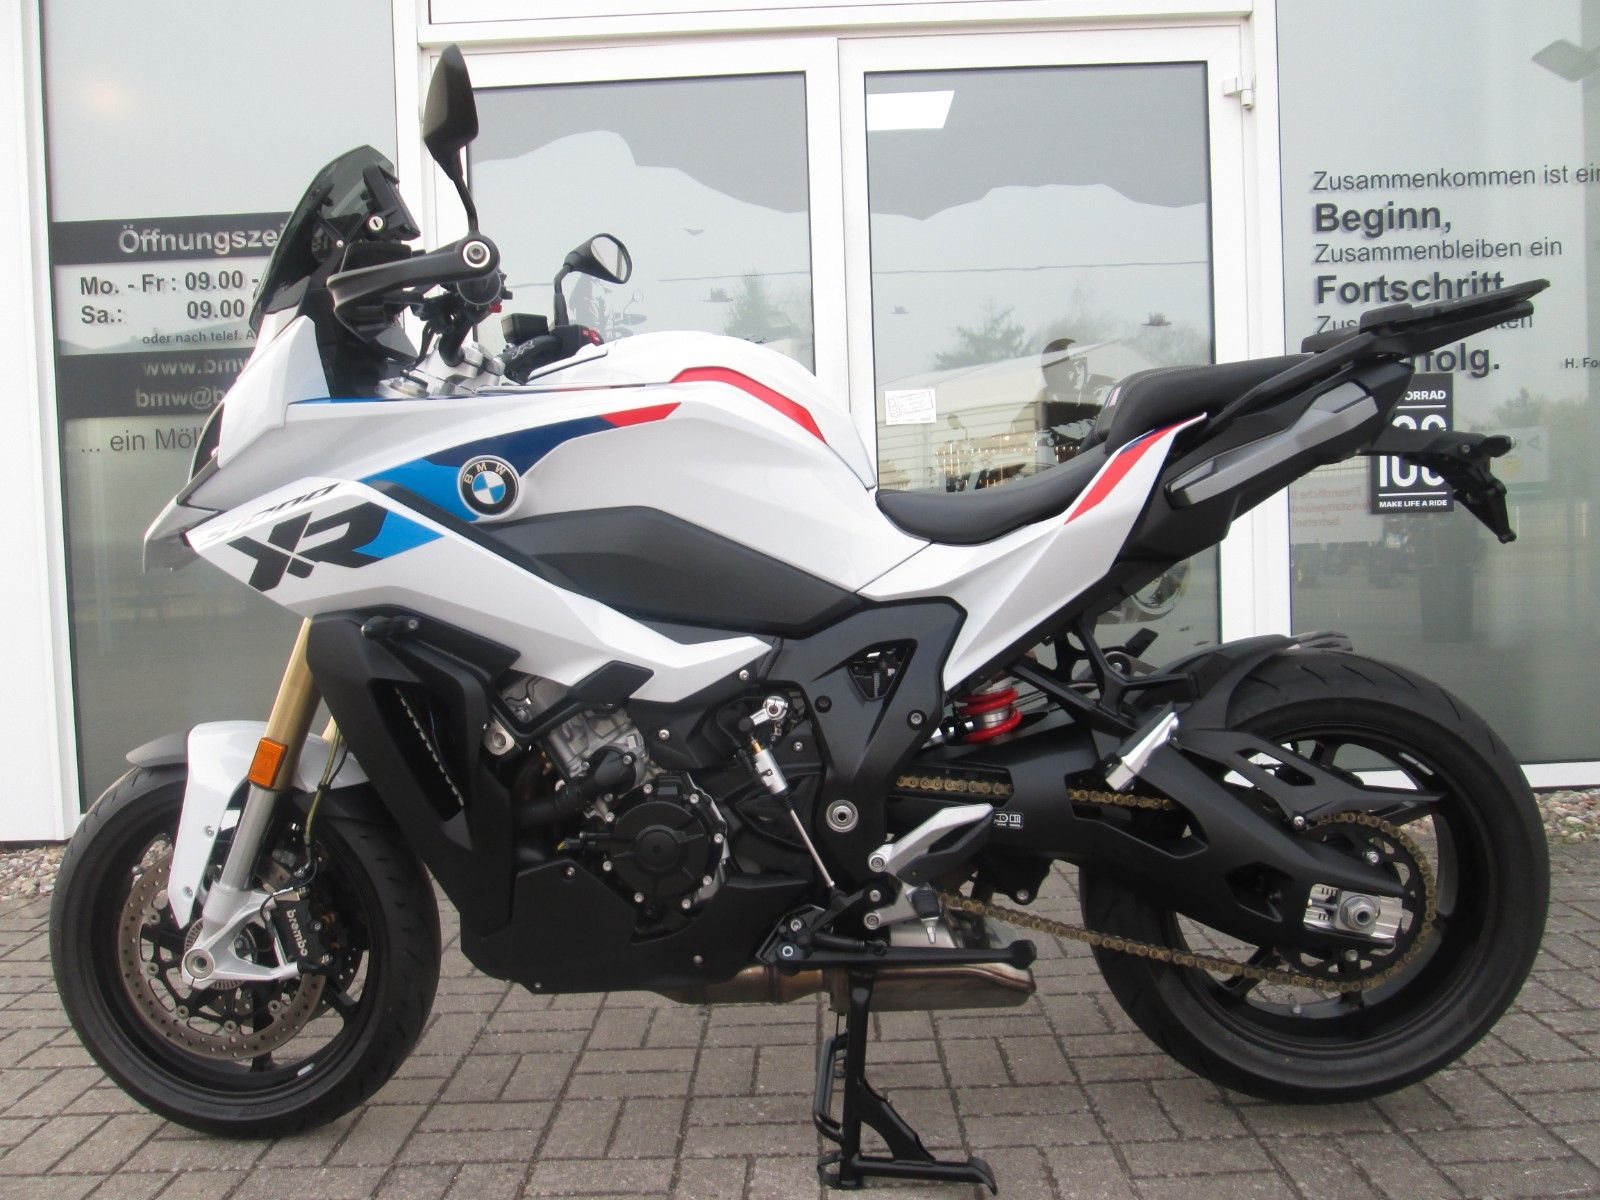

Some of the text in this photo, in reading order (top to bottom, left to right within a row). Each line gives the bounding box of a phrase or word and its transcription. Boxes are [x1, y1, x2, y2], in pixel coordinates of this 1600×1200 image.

[1313, 168, 1535, 191] Zusammenkommen
[1544, 165, 1568, 183] ist
[1315, 201, 1451, 238] Beginn,
[1315, 237, 1562, 263] Zusammenbleiben ein
[80, 276, 119, 295] Mo.
[185, 270, 243, 291] 09.00
[1317, 270, 1504, 304] Fortschritt
[81, 299, 245, 325] Sa.: 09.00
[142, 333, 173, 344] oder
[175, 331, 206, 343] nach
[211, 329, 242, 342] telef.
[1565, 357, 1600, 369] H. Fo
[110, 430, 145, 452] ein
[463, 462, 507, 486] BMW
[286, 909, 308, 956] brembo
